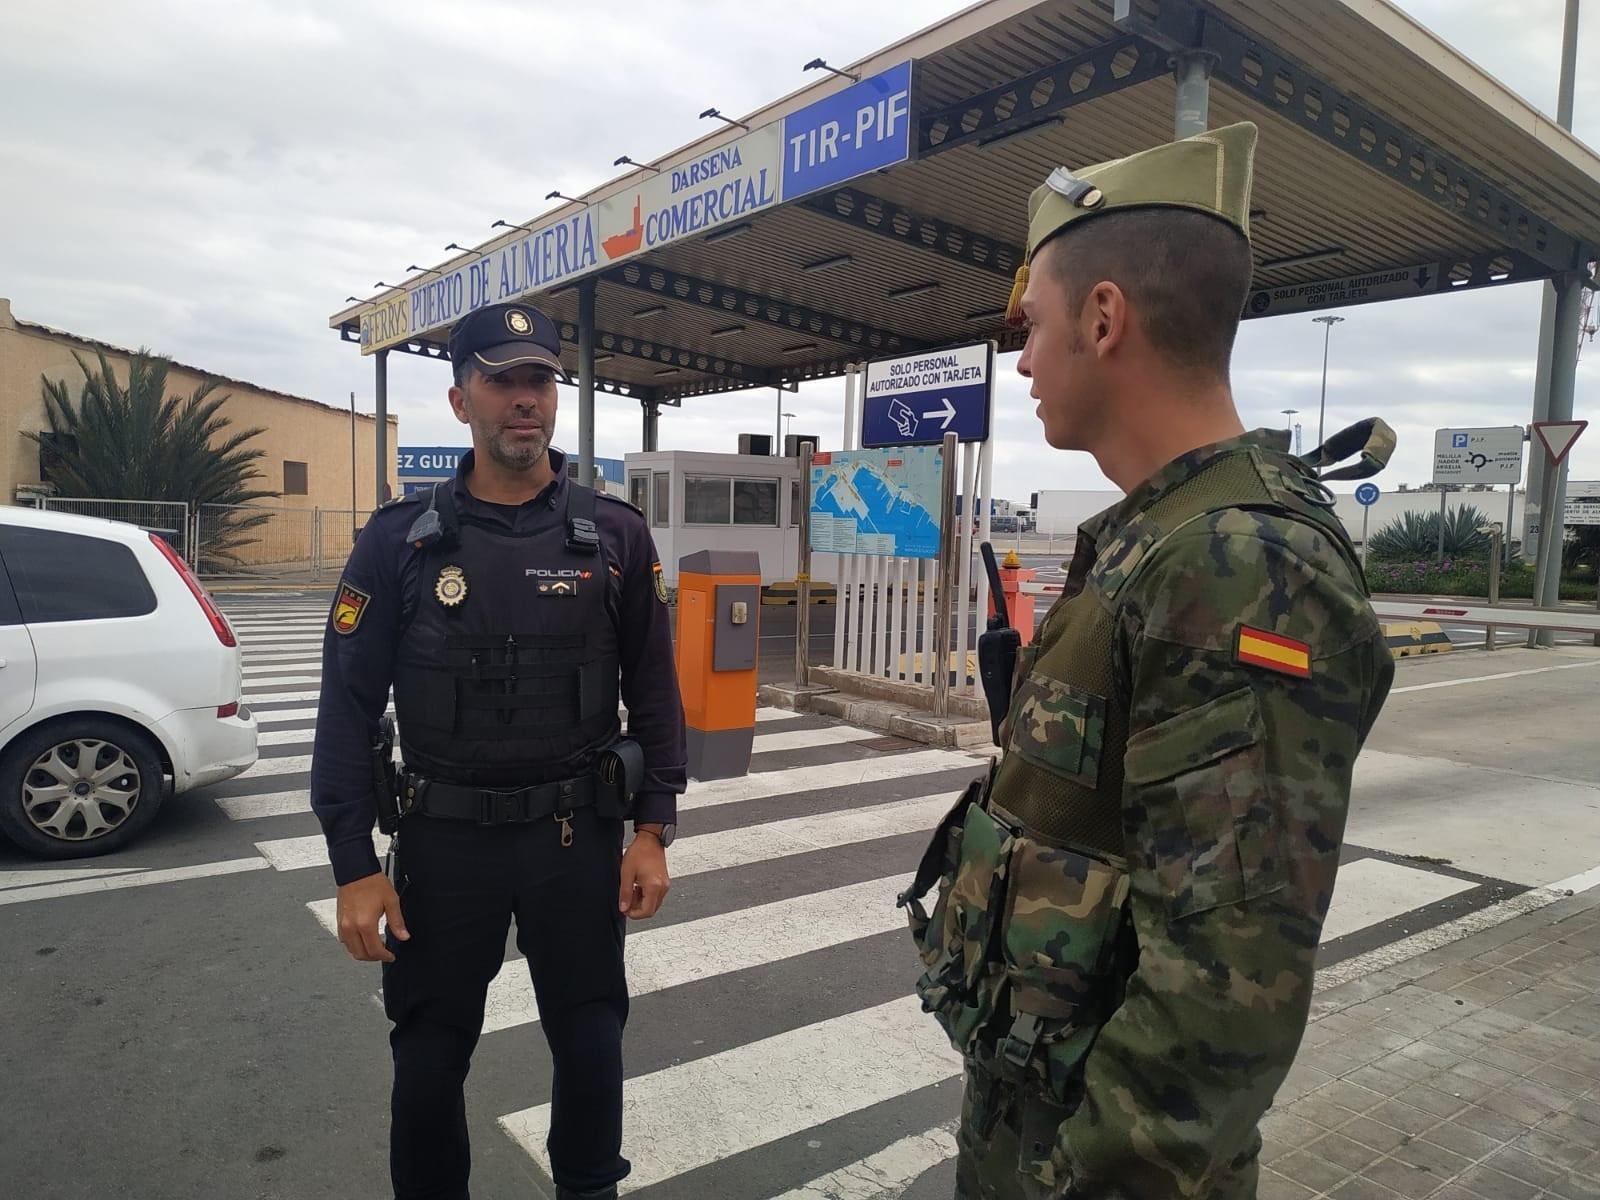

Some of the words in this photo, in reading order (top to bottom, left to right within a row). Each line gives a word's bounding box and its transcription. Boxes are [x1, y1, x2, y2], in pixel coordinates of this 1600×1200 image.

[790, 90, 908, 173] TIR-PIF
[671, 145, 742, 194] DARSENA
[646, 168, 775, 246] COMERCIAL
[411, 272, 463, 332] PUERTO
[469, 258, 491, 311] DE
[498, 212, 597, 299] ALMERIA
[1274, 287, 1296, 300] SOLO
[1299, 284, 1346, 297] PERSONAL
[1349, 271, 1409, 289] AUTORIZADO
[1307, 295, 1326, 305] CON
[368, 299, 408, 346] FERRYS
[870, 374, 920, 393] AUTORIZADO
[922, 372, 940, 385] CON
[942, 366, 981, 383] TARJETA
[890, 362, 912, 377] SOLO
[913, 355, 959, 372] PERSONAL
[1529, 525, 1540, 534] 23
[525, 568, 582, 577] POLICIA
